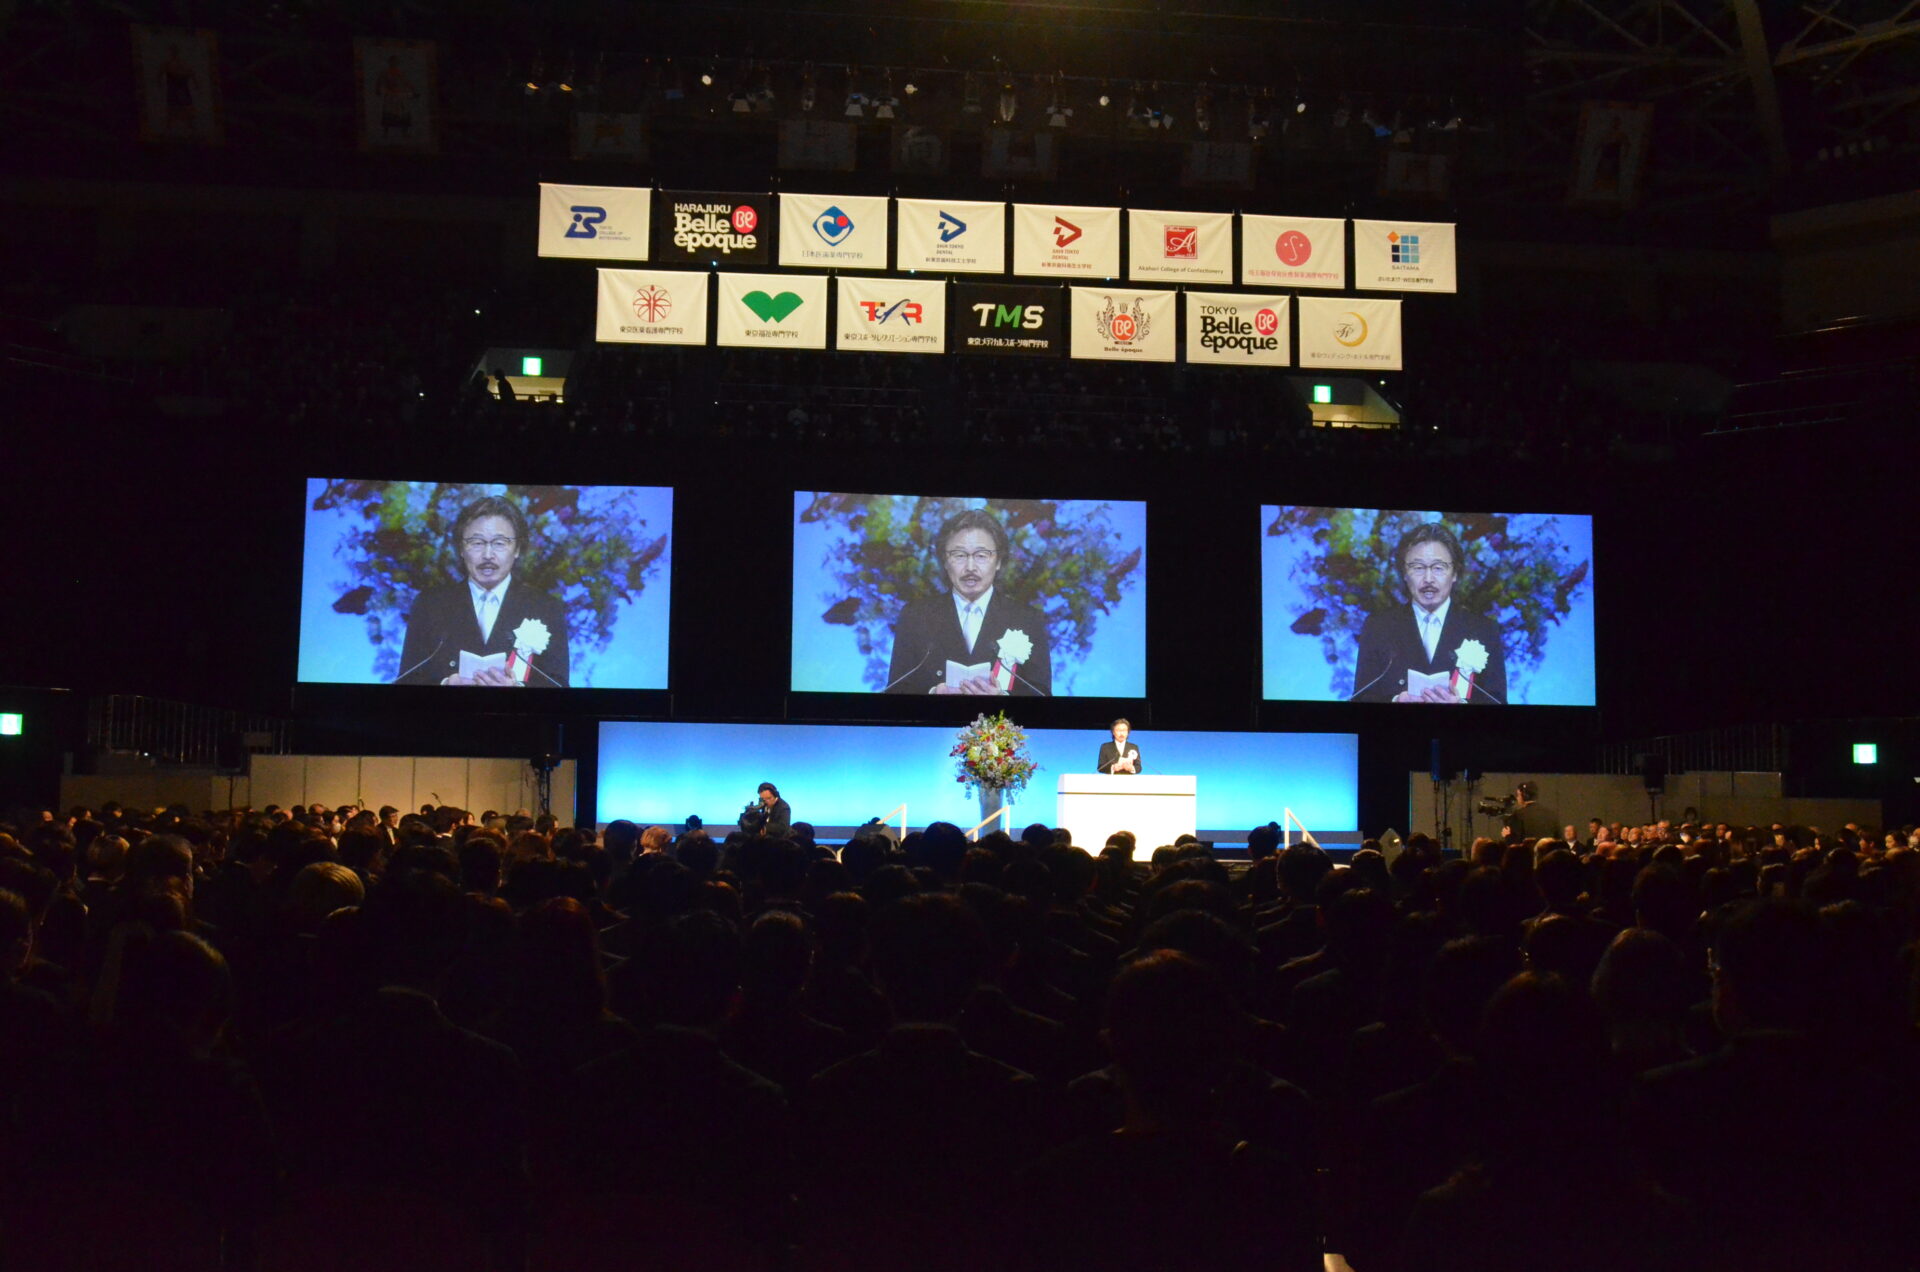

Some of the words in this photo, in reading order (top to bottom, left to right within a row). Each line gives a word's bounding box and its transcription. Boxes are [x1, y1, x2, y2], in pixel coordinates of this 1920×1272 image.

[674, 202, 732, 214] HARAJUKU
[673, 212, 731, 233] Belle
[972, 303, 1045, 329] TMS
[1200, 305, 1237, 315] TOKYO
[1200, 315, 1253, 335] Belle
